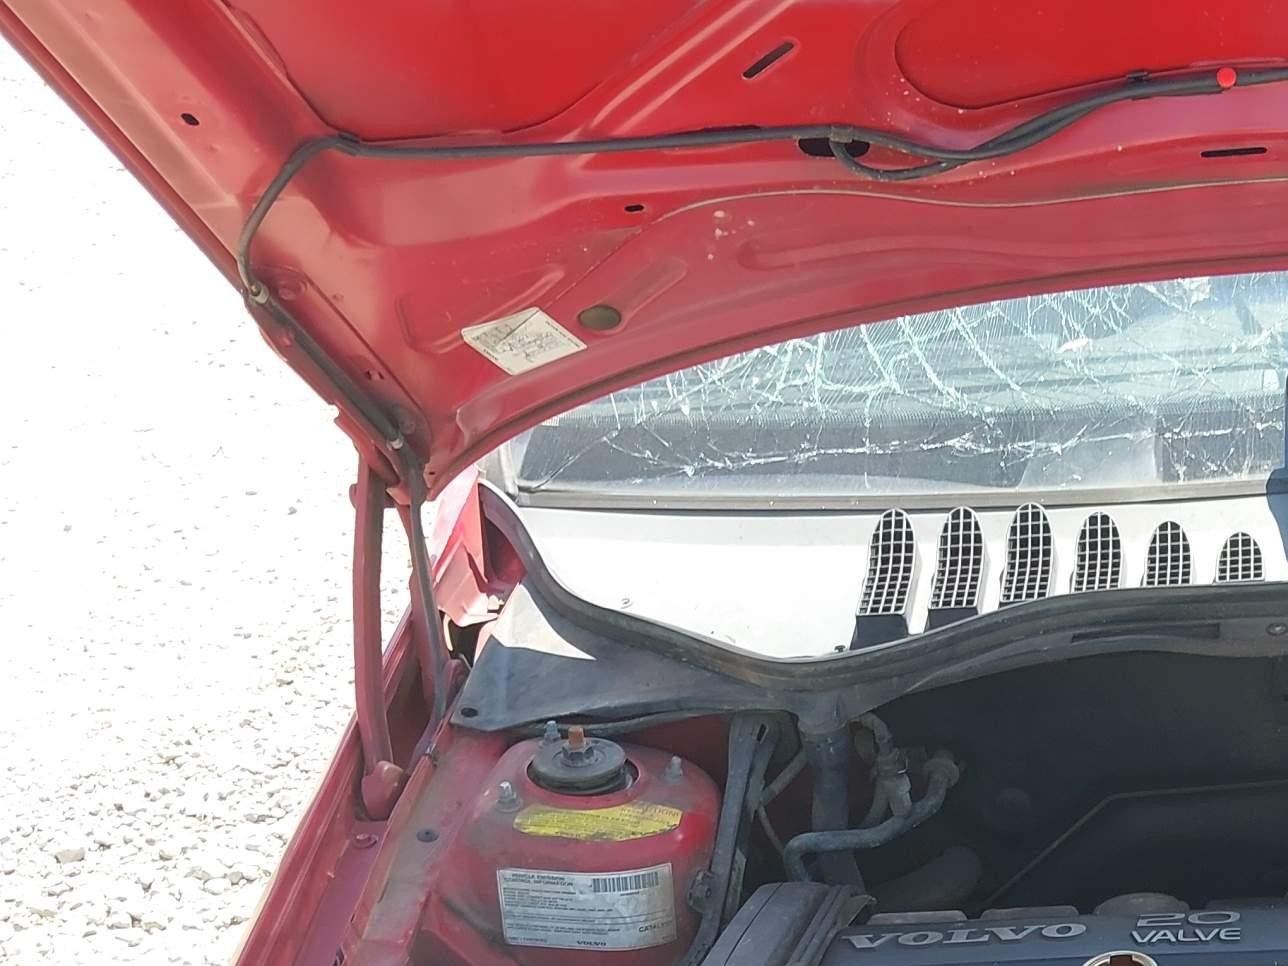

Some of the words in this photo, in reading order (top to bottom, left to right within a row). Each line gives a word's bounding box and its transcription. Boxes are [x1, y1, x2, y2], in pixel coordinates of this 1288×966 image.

[1136, 911, 1242, 928] 20
[842, 922, 1087, 950] VOLVO
[1131, 927, 1242, 945] VALVE
